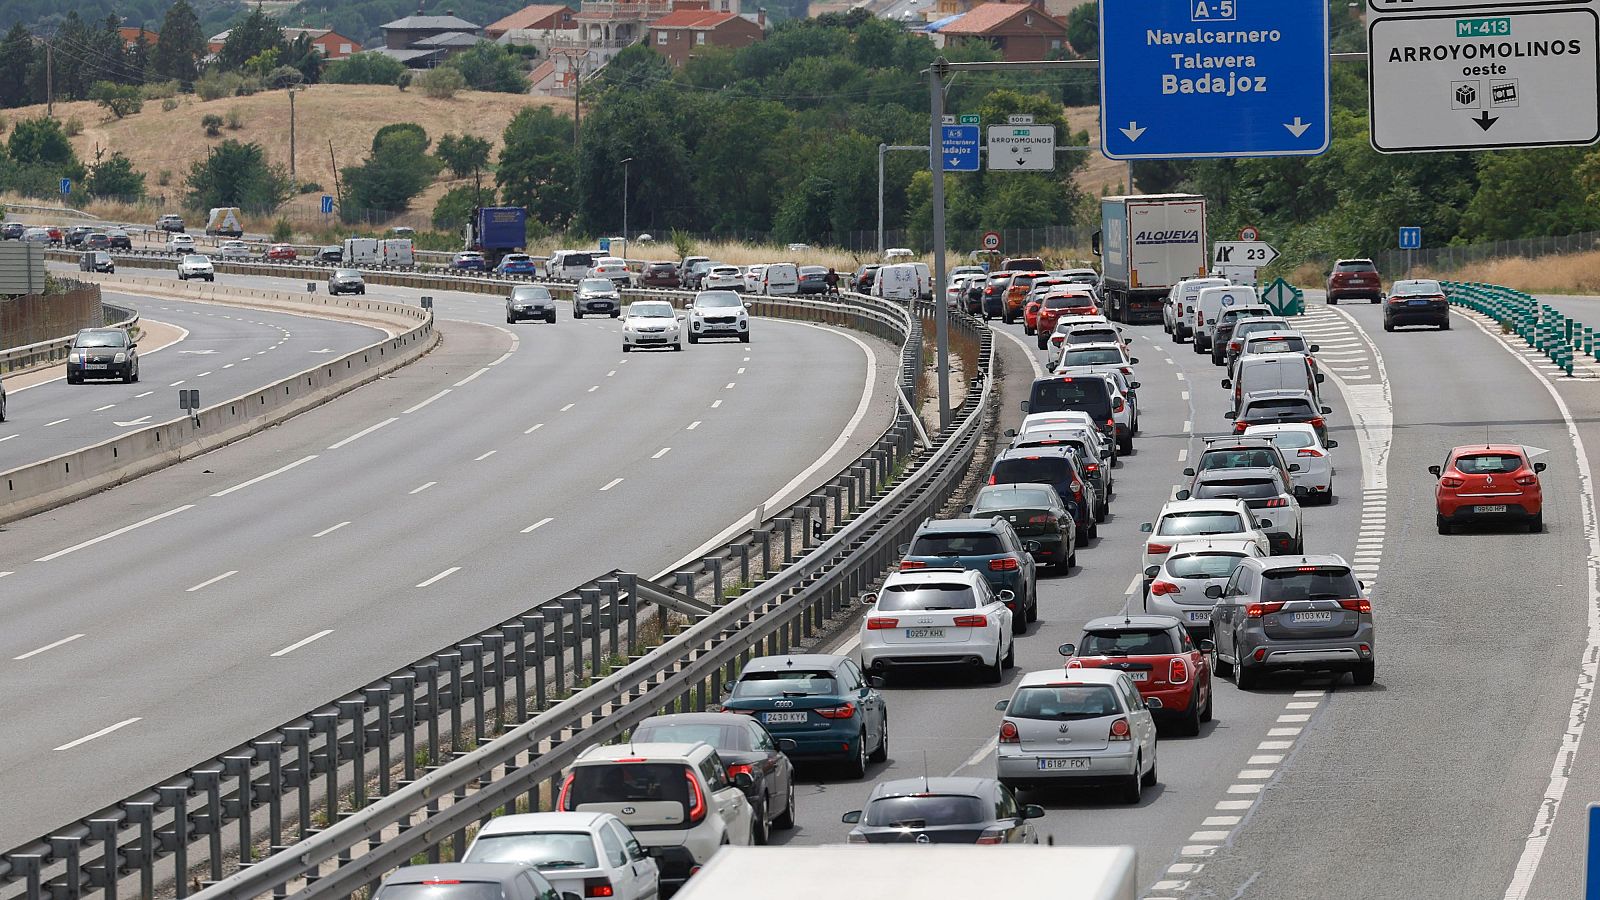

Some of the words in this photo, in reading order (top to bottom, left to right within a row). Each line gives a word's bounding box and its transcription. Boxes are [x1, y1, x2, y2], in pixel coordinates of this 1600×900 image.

[1194, 0, 1233, 18] A-5
[1458, 20, 1509, 35] M-413
[1146, 28, 1281, 46] Navalcarnero
[1388, 39, 1581, 62] ARROYOMOLINOS
[1171, 53, 1256, 70] Talavera
[1462, 62, 1507, 76] oeste
[1162, 71, 1267, 96] Badajoz
[1135, 230, 1199, 241] ALQUEVA
[1247, 249, 1265, 260] 23
[1296, 612, 1314, 620] 0103
[1316, 611, 1331, 619] KVZ
[767, 713, 789, 721] 2430
[1047, 760, 1067, 768] 6187
[1070, 759, 1086, 768] FCK
